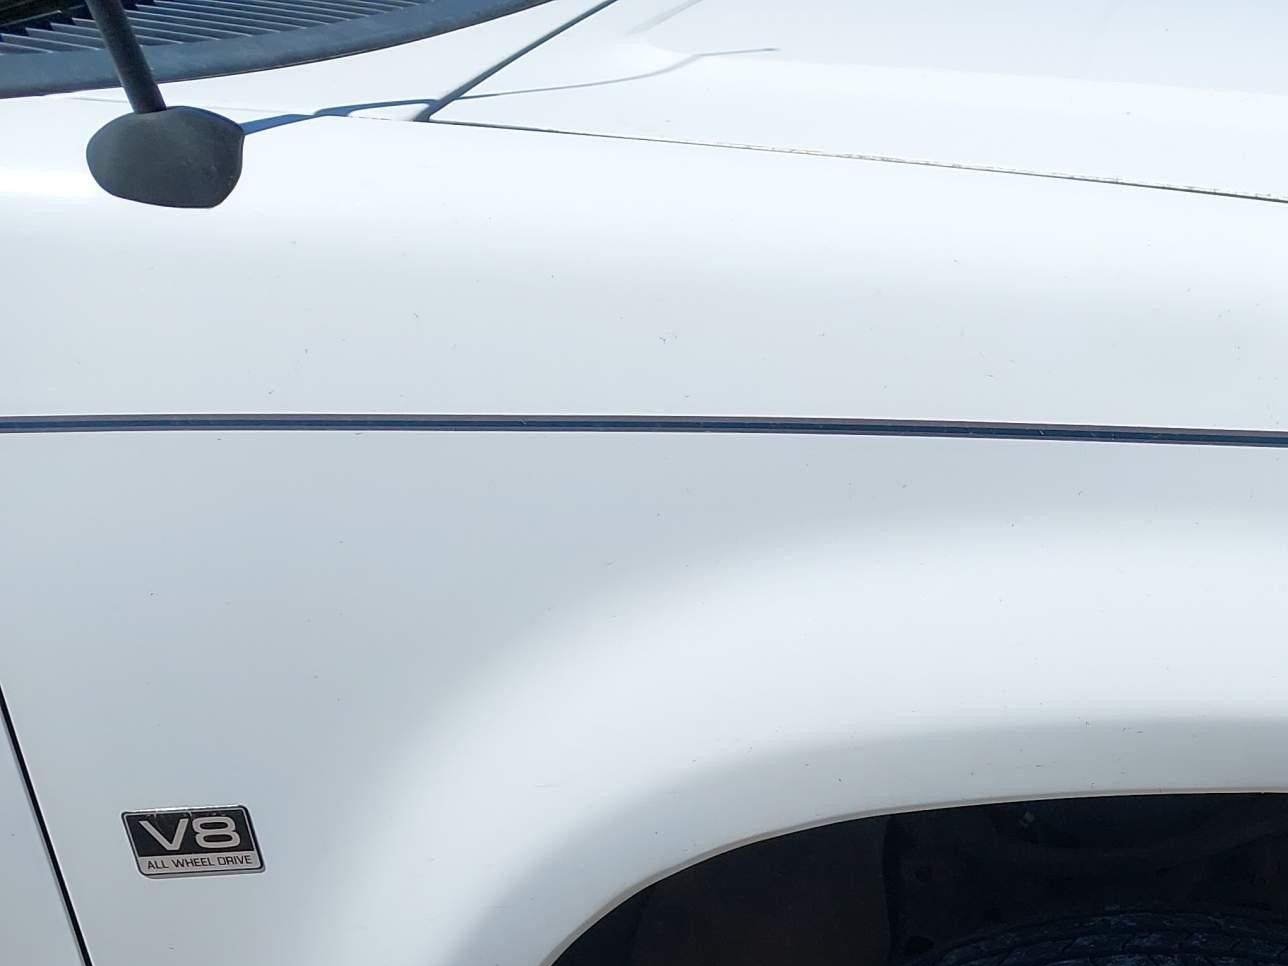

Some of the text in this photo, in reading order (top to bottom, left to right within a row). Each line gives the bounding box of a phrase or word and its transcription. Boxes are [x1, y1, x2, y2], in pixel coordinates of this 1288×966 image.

[138, 816, 241, 851] V8
[147, 854, 253, 870] ALL WHEEL DRIVE
